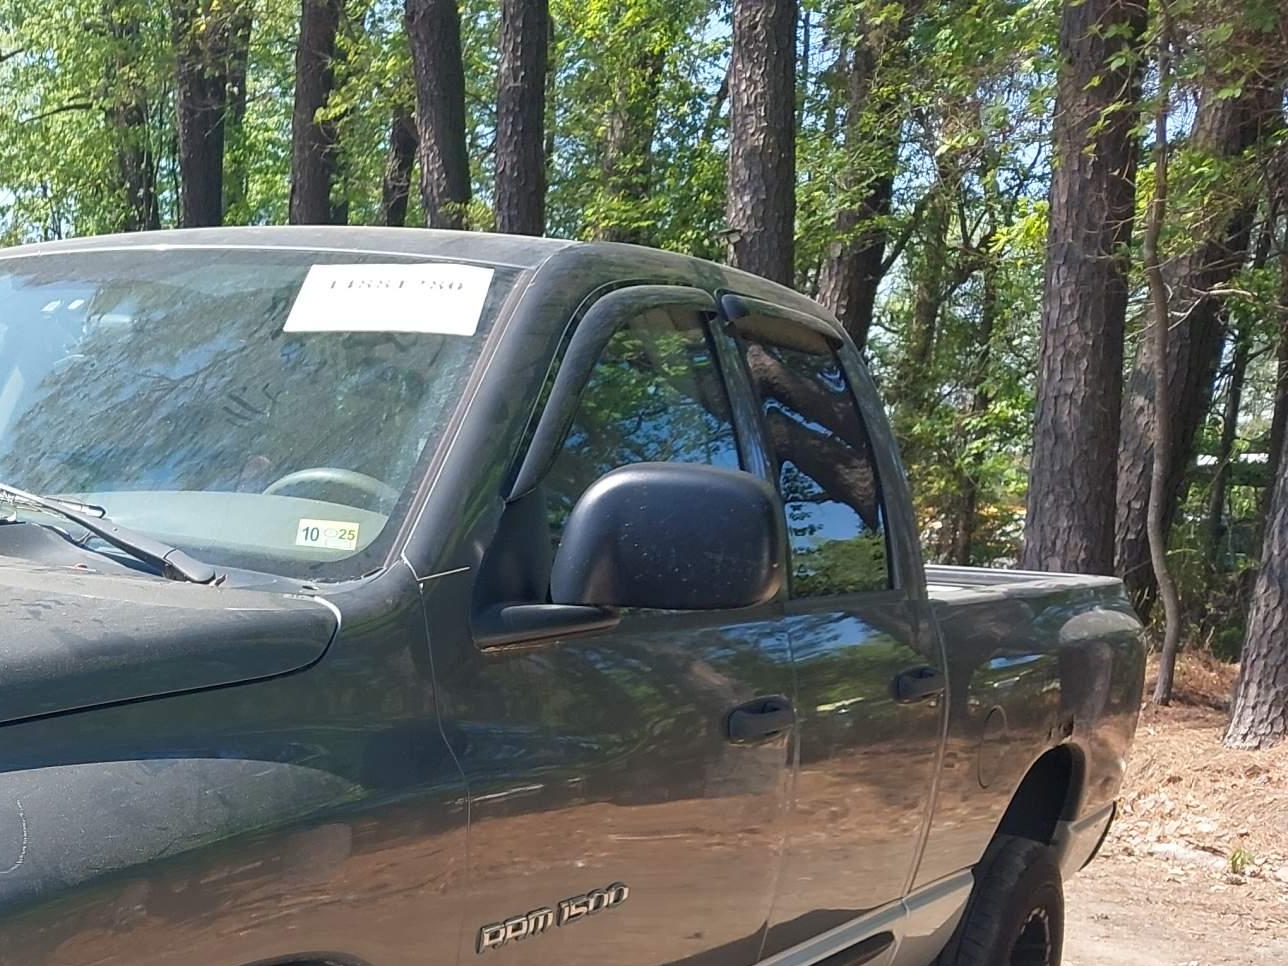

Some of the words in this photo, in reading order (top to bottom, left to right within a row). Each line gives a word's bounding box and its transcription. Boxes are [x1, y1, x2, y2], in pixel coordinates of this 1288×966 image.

[302, 526, 320, 542] 10
[338, 528, 356, 541] 25
[476, 906, 553, 954] RAM
[557, 881, 630, 927] 1500
